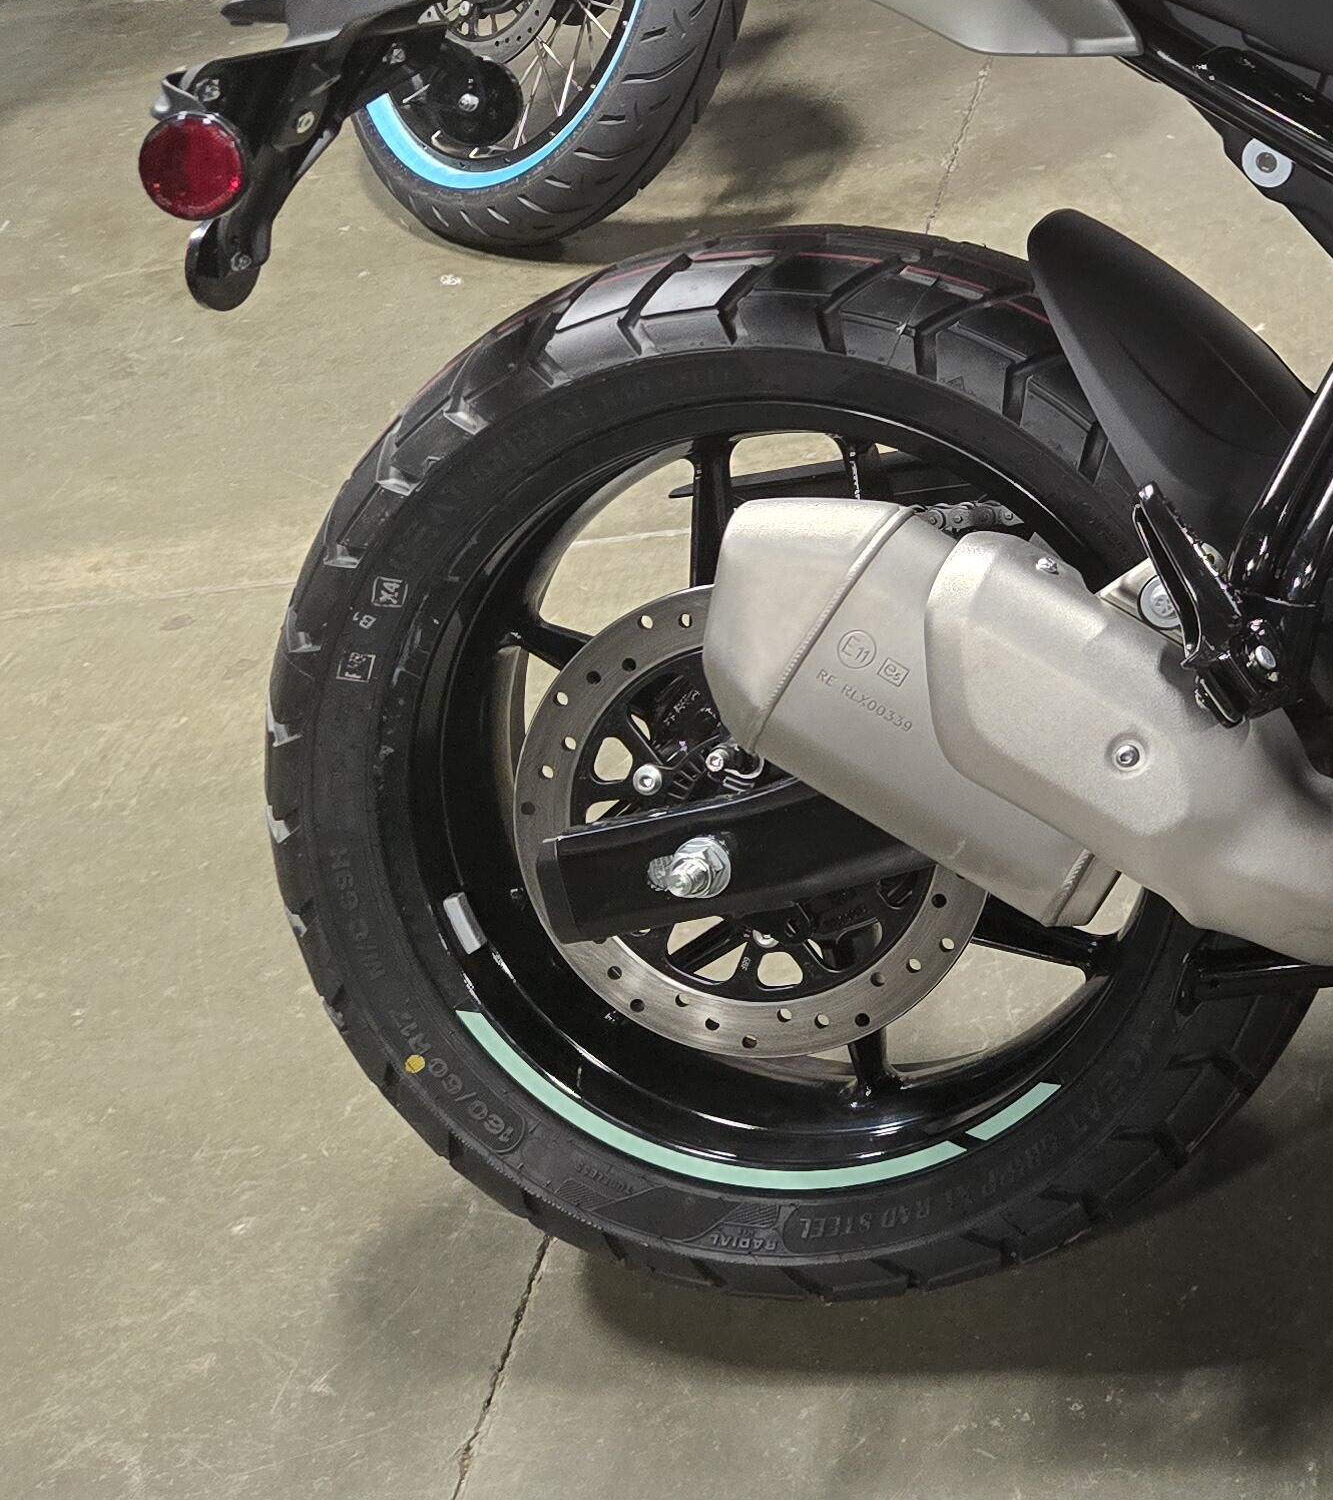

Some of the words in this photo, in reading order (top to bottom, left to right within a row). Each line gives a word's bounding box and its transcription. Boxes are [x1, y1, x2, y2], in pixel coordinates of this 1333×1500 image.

[816, 669, 837, 687] RE
[841, 683, 913, 732] RLX00339
[427, 1059, 515, 1145] 160/60
[797, 1210, 872, 1239] STEEL
[880, 1196, 931, 1231] RAD
[707, 1232, 777, 1251] RADIAL
